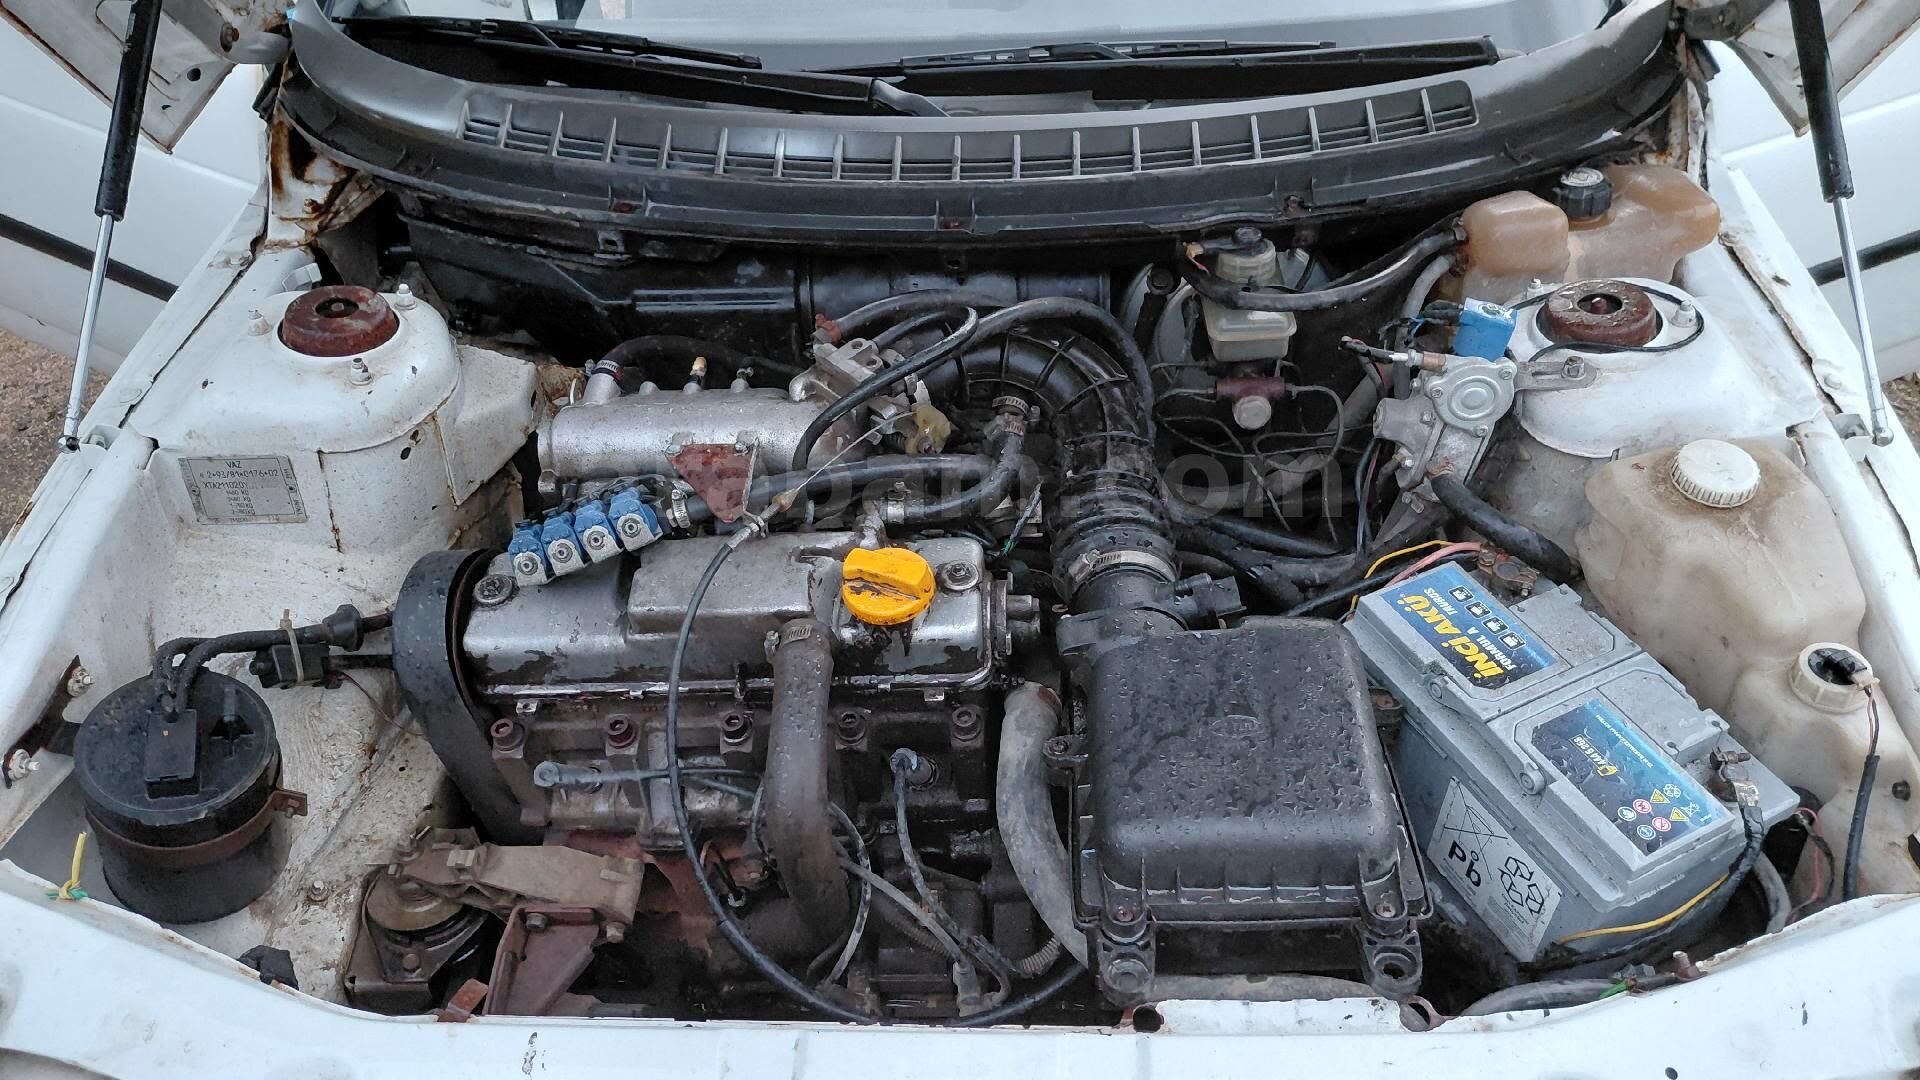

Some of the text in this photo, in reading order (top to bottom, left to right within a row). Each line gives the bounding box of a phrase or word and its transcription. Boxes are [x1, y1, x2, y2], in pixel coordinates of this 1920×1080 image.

[225, 460, 243, 469] VAZ
[1397, 594, 1462, 635] AKÜ
[1423, 587, 1459, 616] TAURUS
[1466, 626, 1479, 635] A
[1475, 633, 1516, 671] FORMUL
[1448, 839, 1482, 887] Pb
